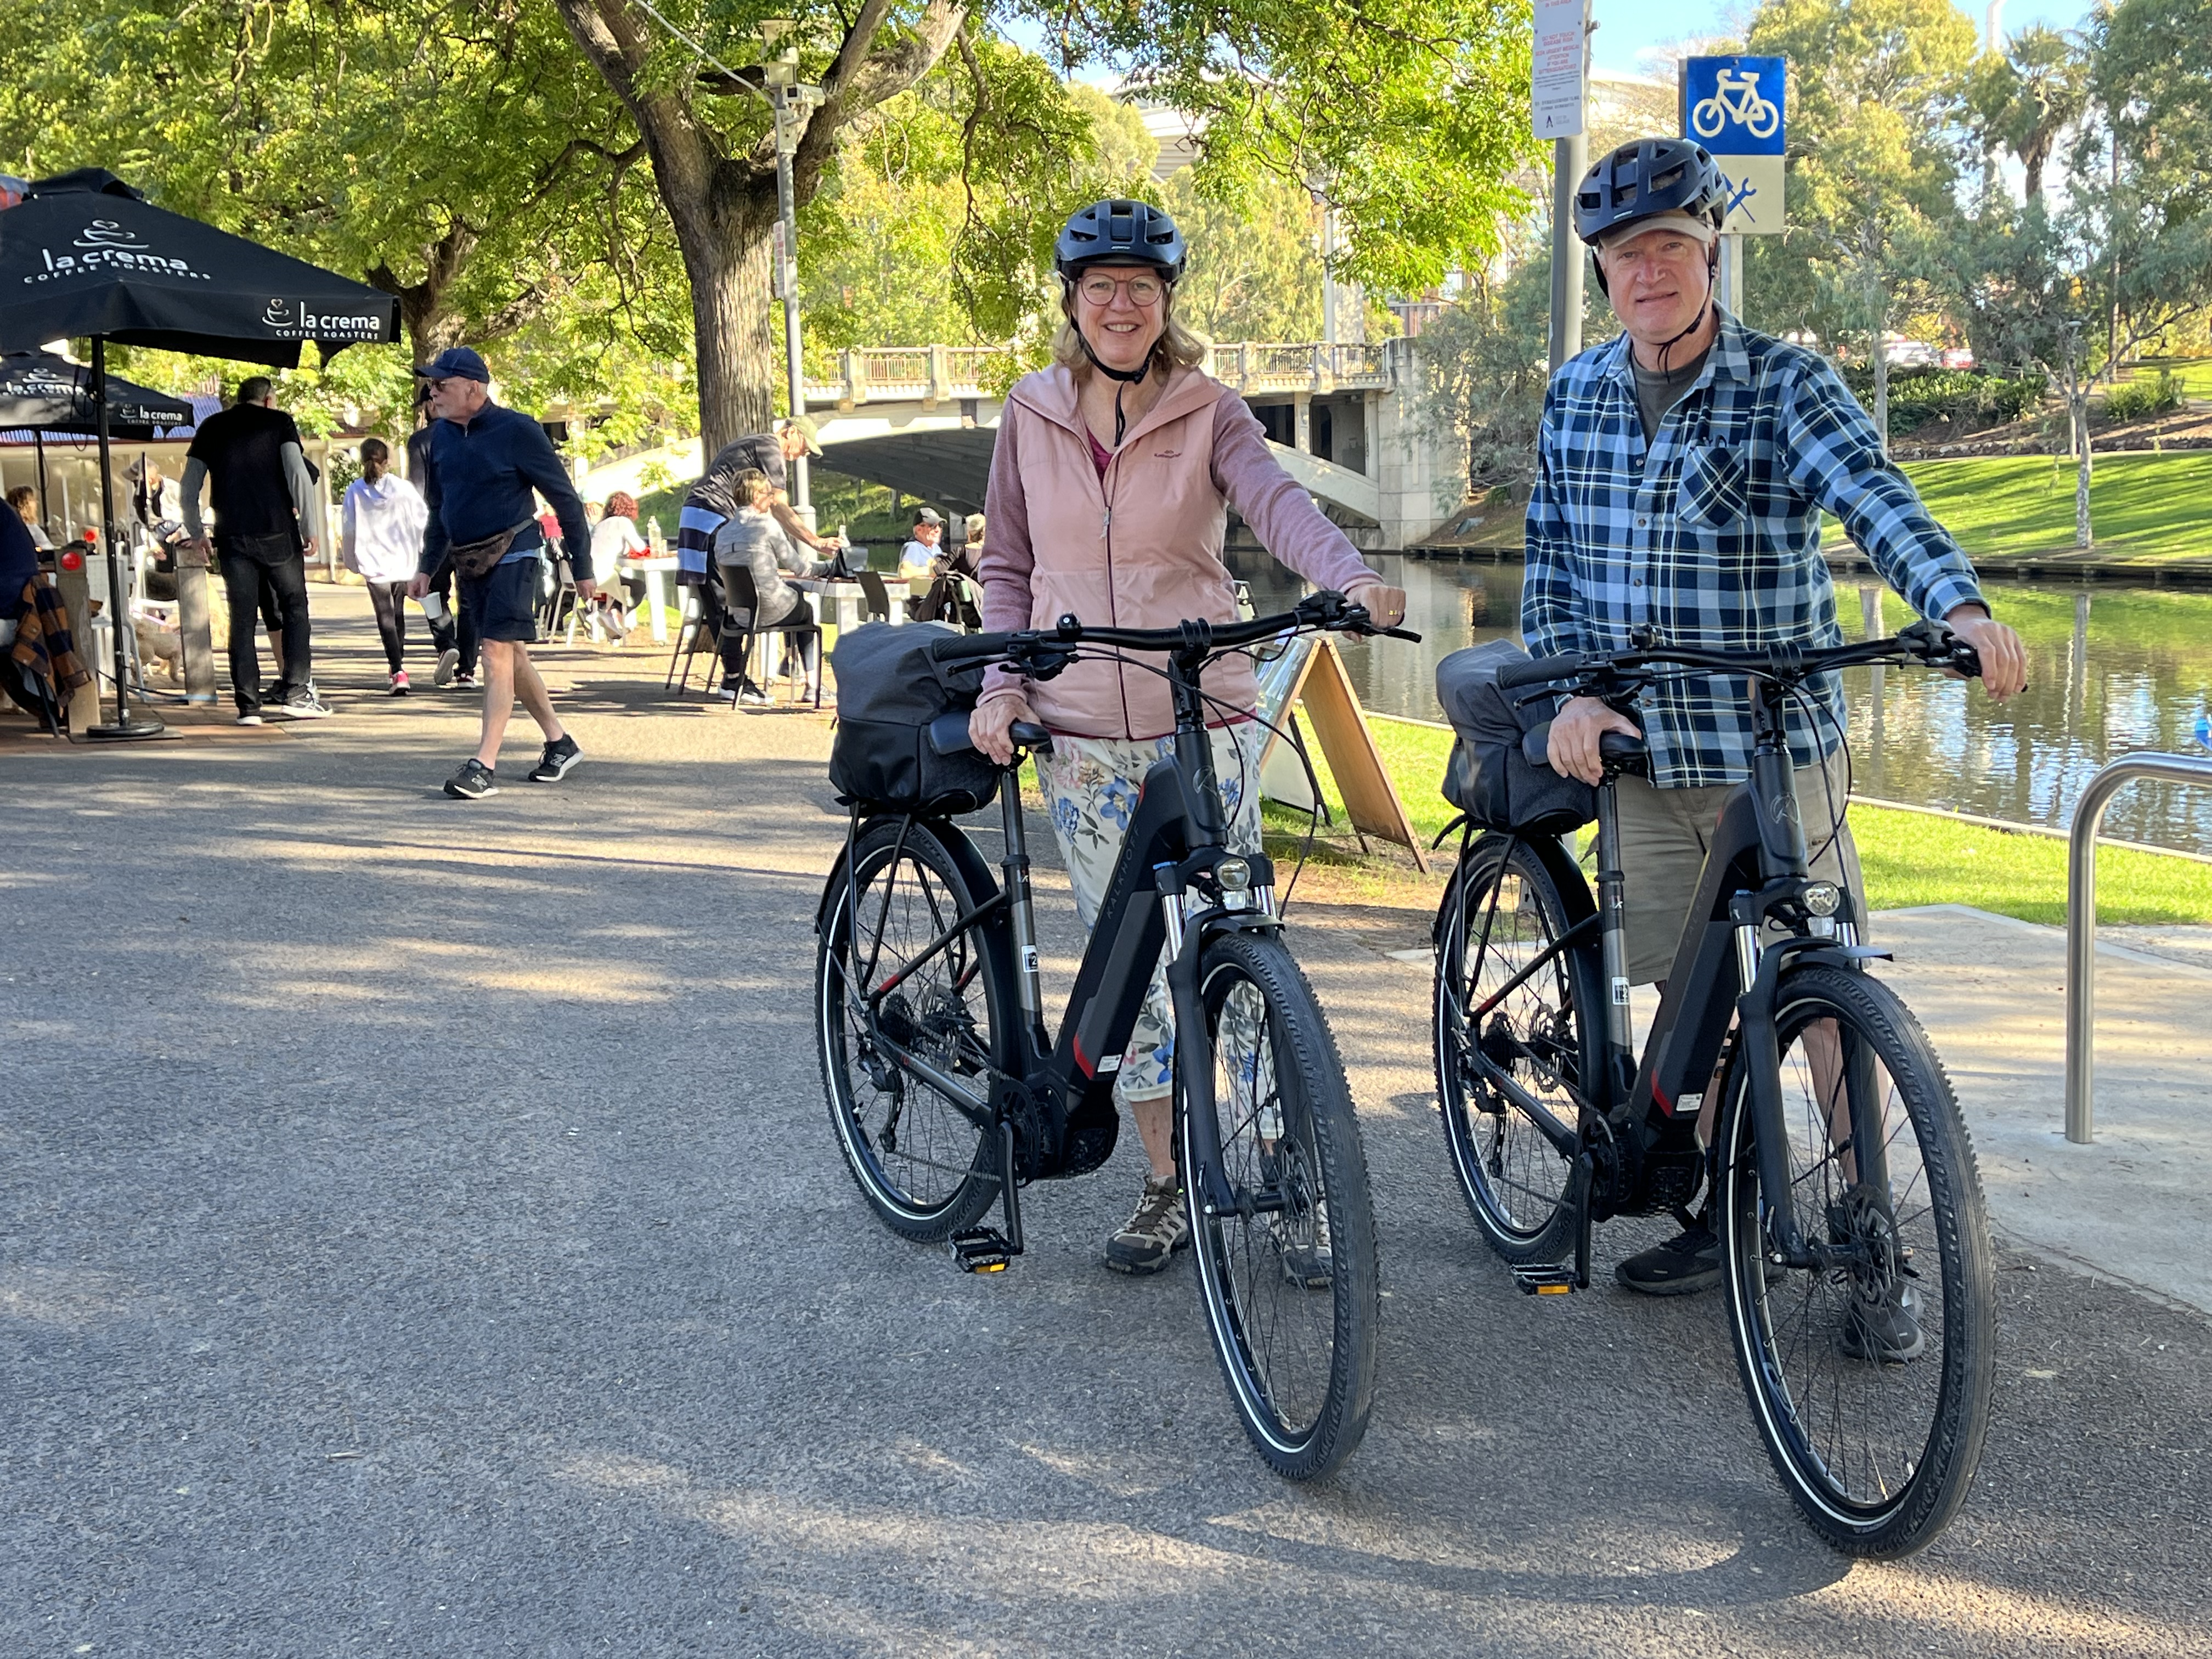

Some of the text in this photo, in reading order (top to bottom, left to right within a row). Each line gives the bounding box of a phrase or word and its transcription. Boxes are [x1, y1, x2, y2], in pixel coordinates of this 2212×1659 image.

[42, 249, 189, 272] la crema
[24, 264, 97, 283] COFFEE
[300, 301, 380, 330] la crema
[275, 330, 378, 340] COFFEE ROASTERS
[6, 381, 24, 392] la
[140, 405, 182, 421] la crema
[1106, 825, 1139, 919] KALKHOFF
